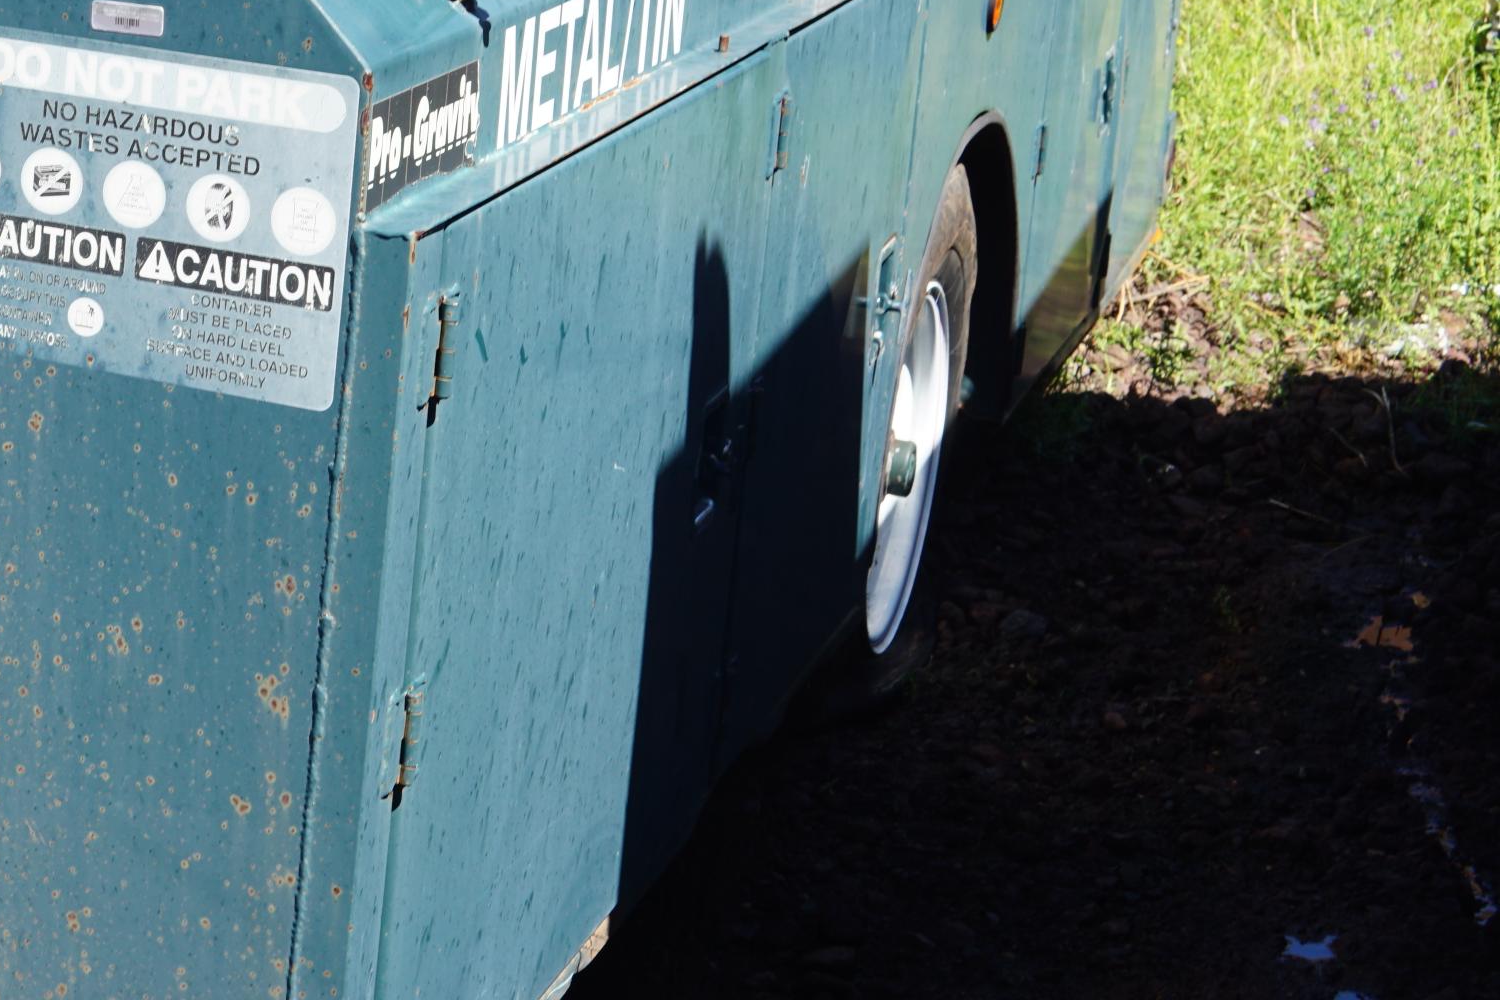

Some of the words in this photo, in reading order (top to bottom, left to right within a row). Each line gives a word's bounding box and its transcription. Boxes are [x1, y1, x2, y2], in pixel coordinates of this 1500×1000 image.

[65, 50, 165, 105] NOT
[175, 66, 310, 127] PARK
[43, 99, 77, 121] NO
[86, 105, 240, 147] HAZARDOUS
[20, 122, 119, 155] WASTES
[127, 140, 260, 176] ACCEPTED
[29, 271, 44, 285] ON
[47, 274, 61, 287] OR
[63, 277, 107, 296] AROUND
[176, 248, 332, 307] CAUTION
[44, 293, 67, 308] THIS
[191, 293, 273, 318] CONTAINER
[168, 307, 208, 326] MUST
[212, 316, 230, 329] BE
[235, 319, 292, 340] PLACED
[172, 324, 192, 340] ON
[197, 330, 237, 348] HARD
[241, 339, 285, 357] LEVEL
[147, 338, 211, 361] SURFACE
[216, 350, 245, 368] AND
[250, 359, 309, 379] LOADED
[185, 364, 267, 389] UNIFORMLY
